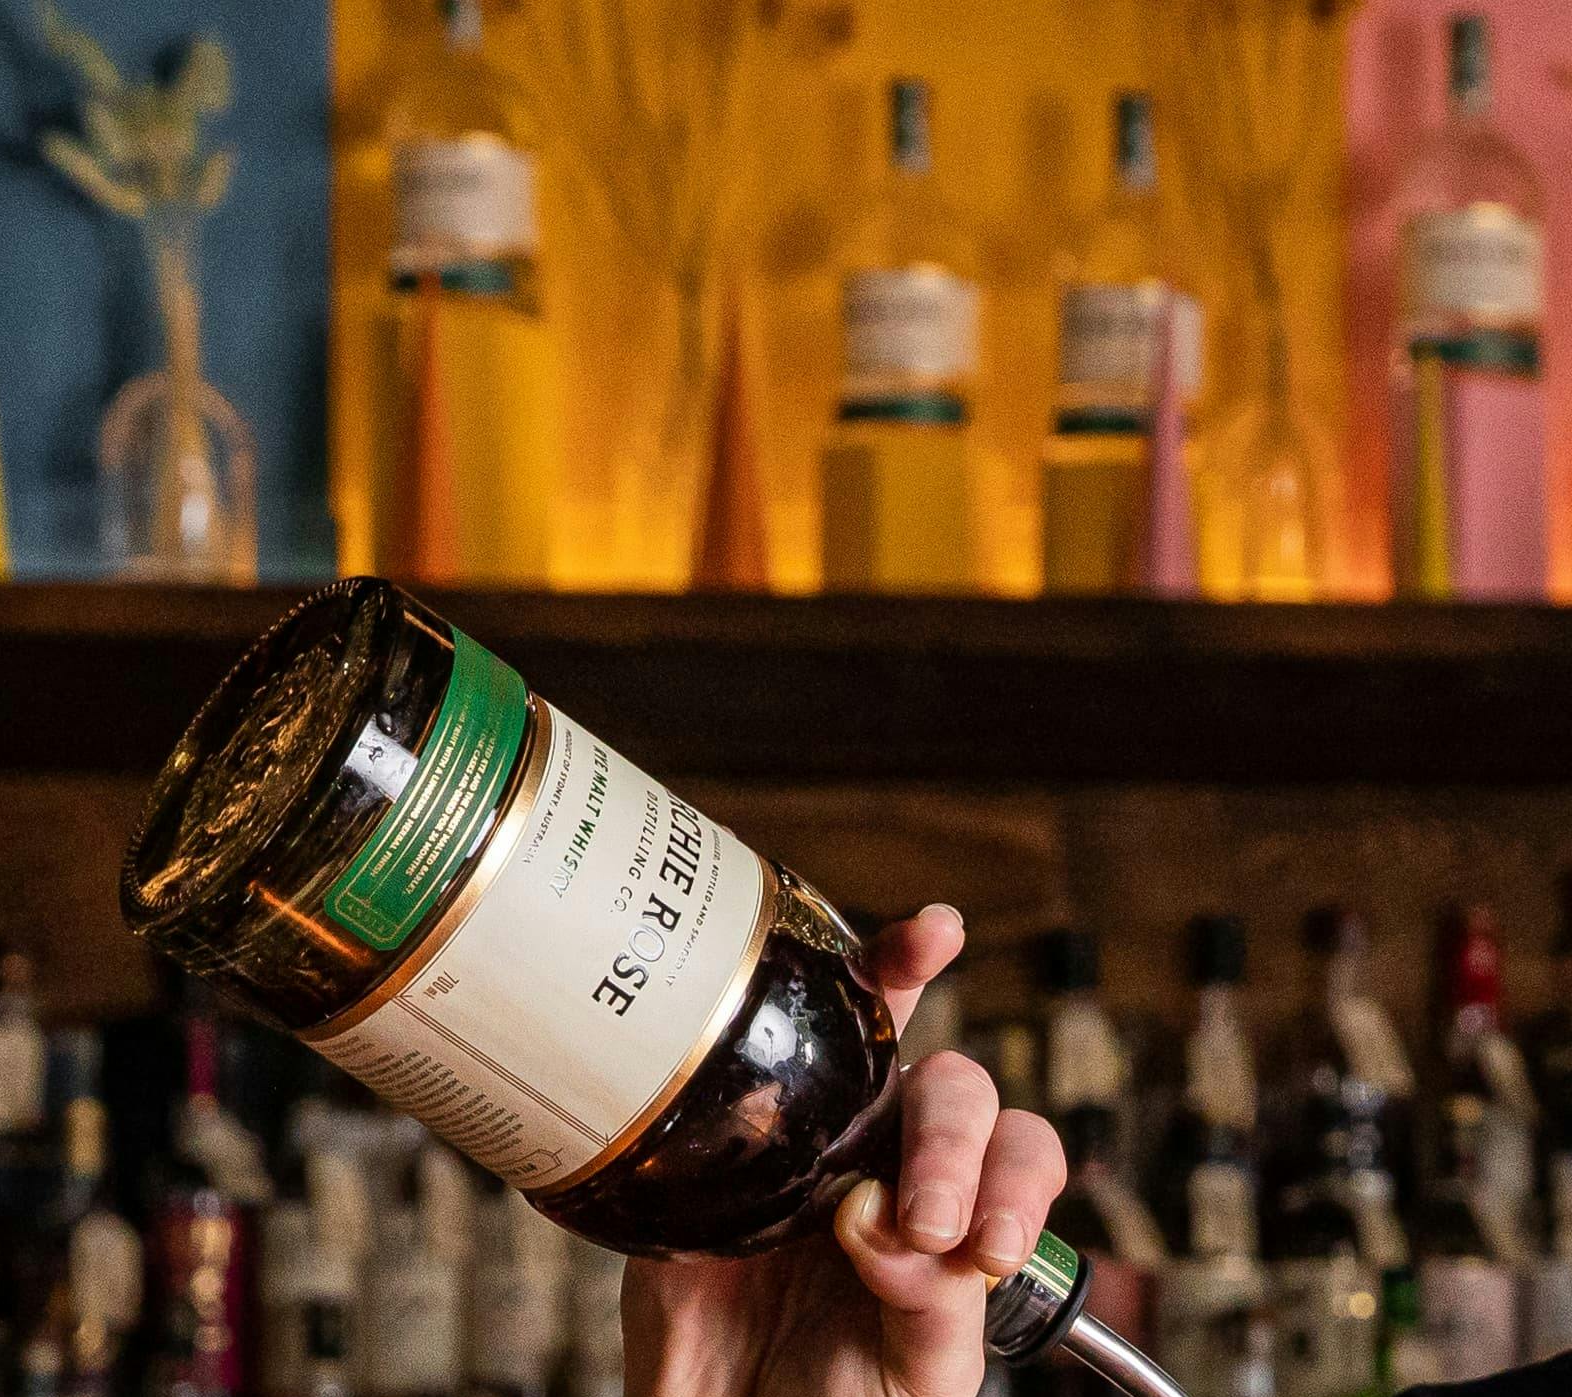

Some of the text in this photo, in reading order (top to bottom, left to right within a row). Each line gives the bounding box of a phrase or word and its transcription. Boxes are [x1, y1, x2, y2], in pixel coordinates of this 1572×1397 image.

[563, 728, 572, 759] PRODUCT
[434, 766, 443, 774] A
[561, 759, 569, 772] OF
[468, 771, 482, 792] AND
[548, 771, 567, 806] SYDNEY,
[459, 790, 474, 808] THE
[548, 744, 608, 899] RYE MALT WHISKY
[627, 790, 658, 880] DISTILLING
[590, 793, 702, 1017] RCHIE ROSE
[696, 903, 708, 926] AND
